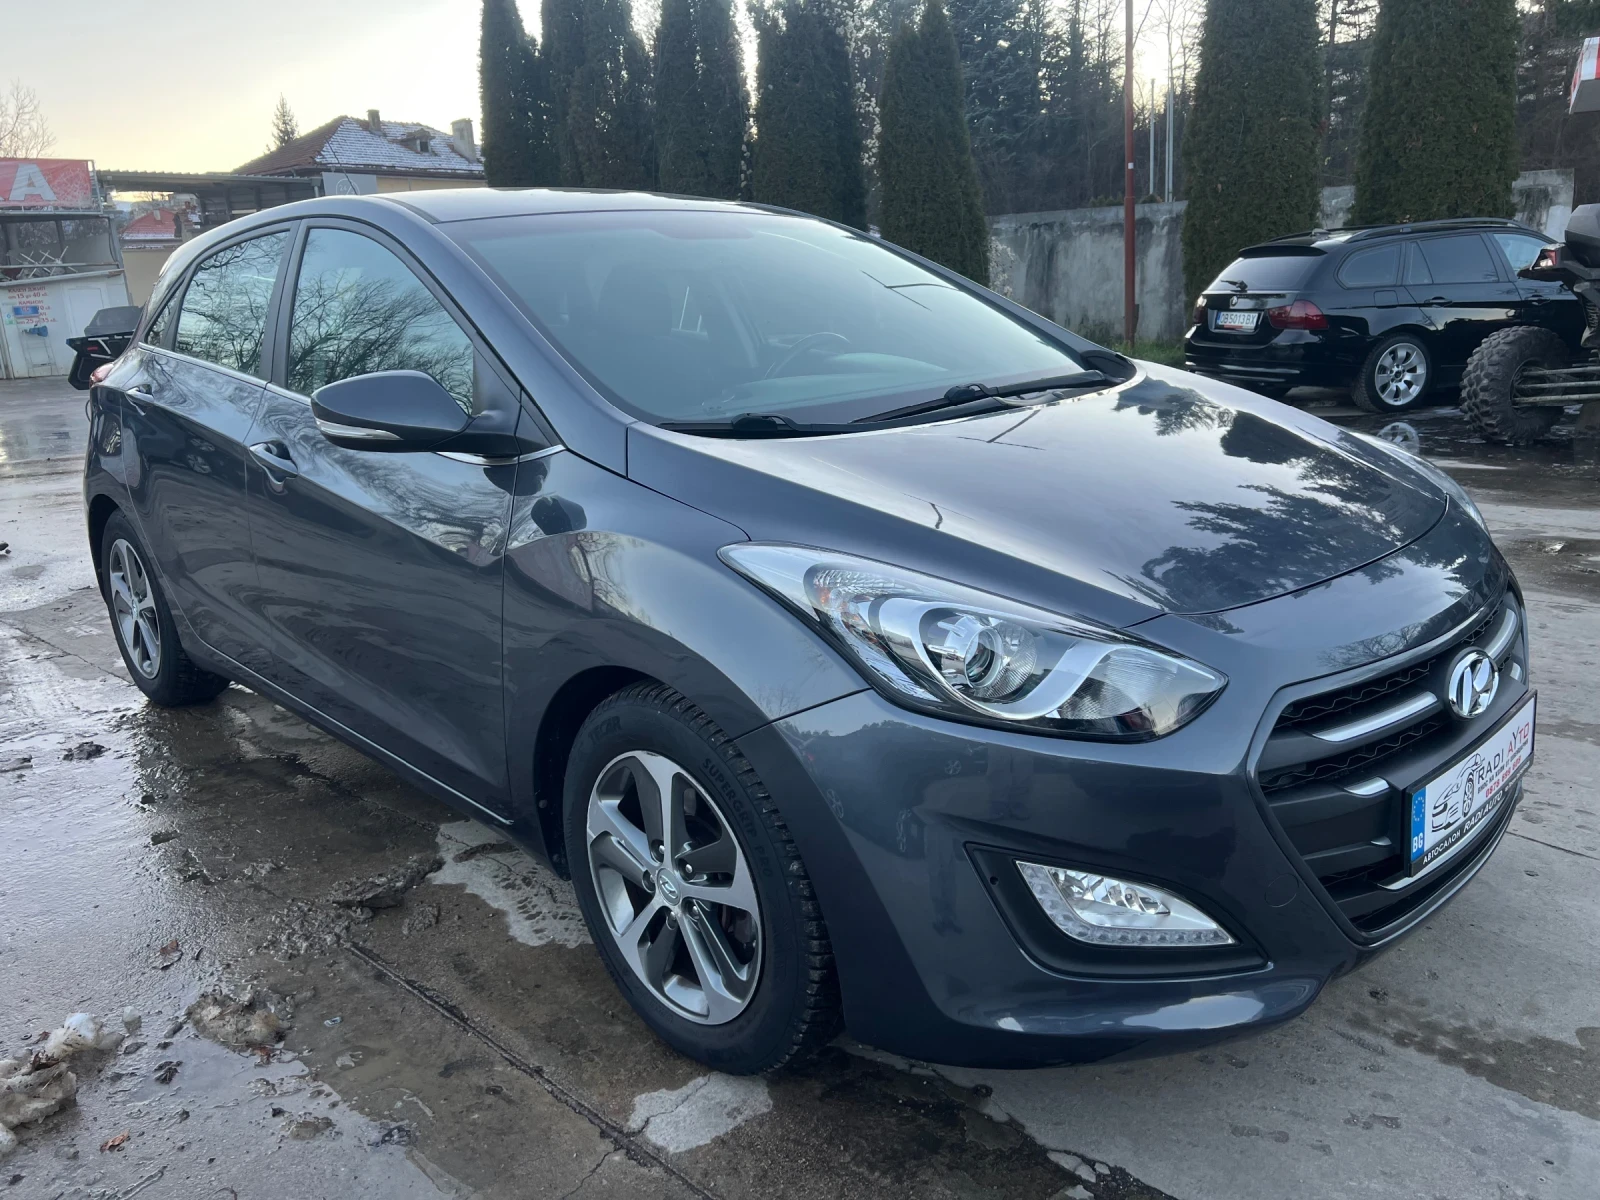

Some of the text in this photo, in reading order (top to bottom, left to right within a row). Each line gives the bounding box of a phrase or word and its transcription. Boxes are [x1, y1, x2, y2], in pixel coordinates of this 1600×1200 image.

[1477, 749, 1504, 785] RADI
[702, 757, 773, 877] SUPERGRIP PRO
[1422, 829, 1461, 865] АВТОСАЛОН
[1463, 809, 1484, 833] RADI
[1412, 832, 1424, 853] BG
